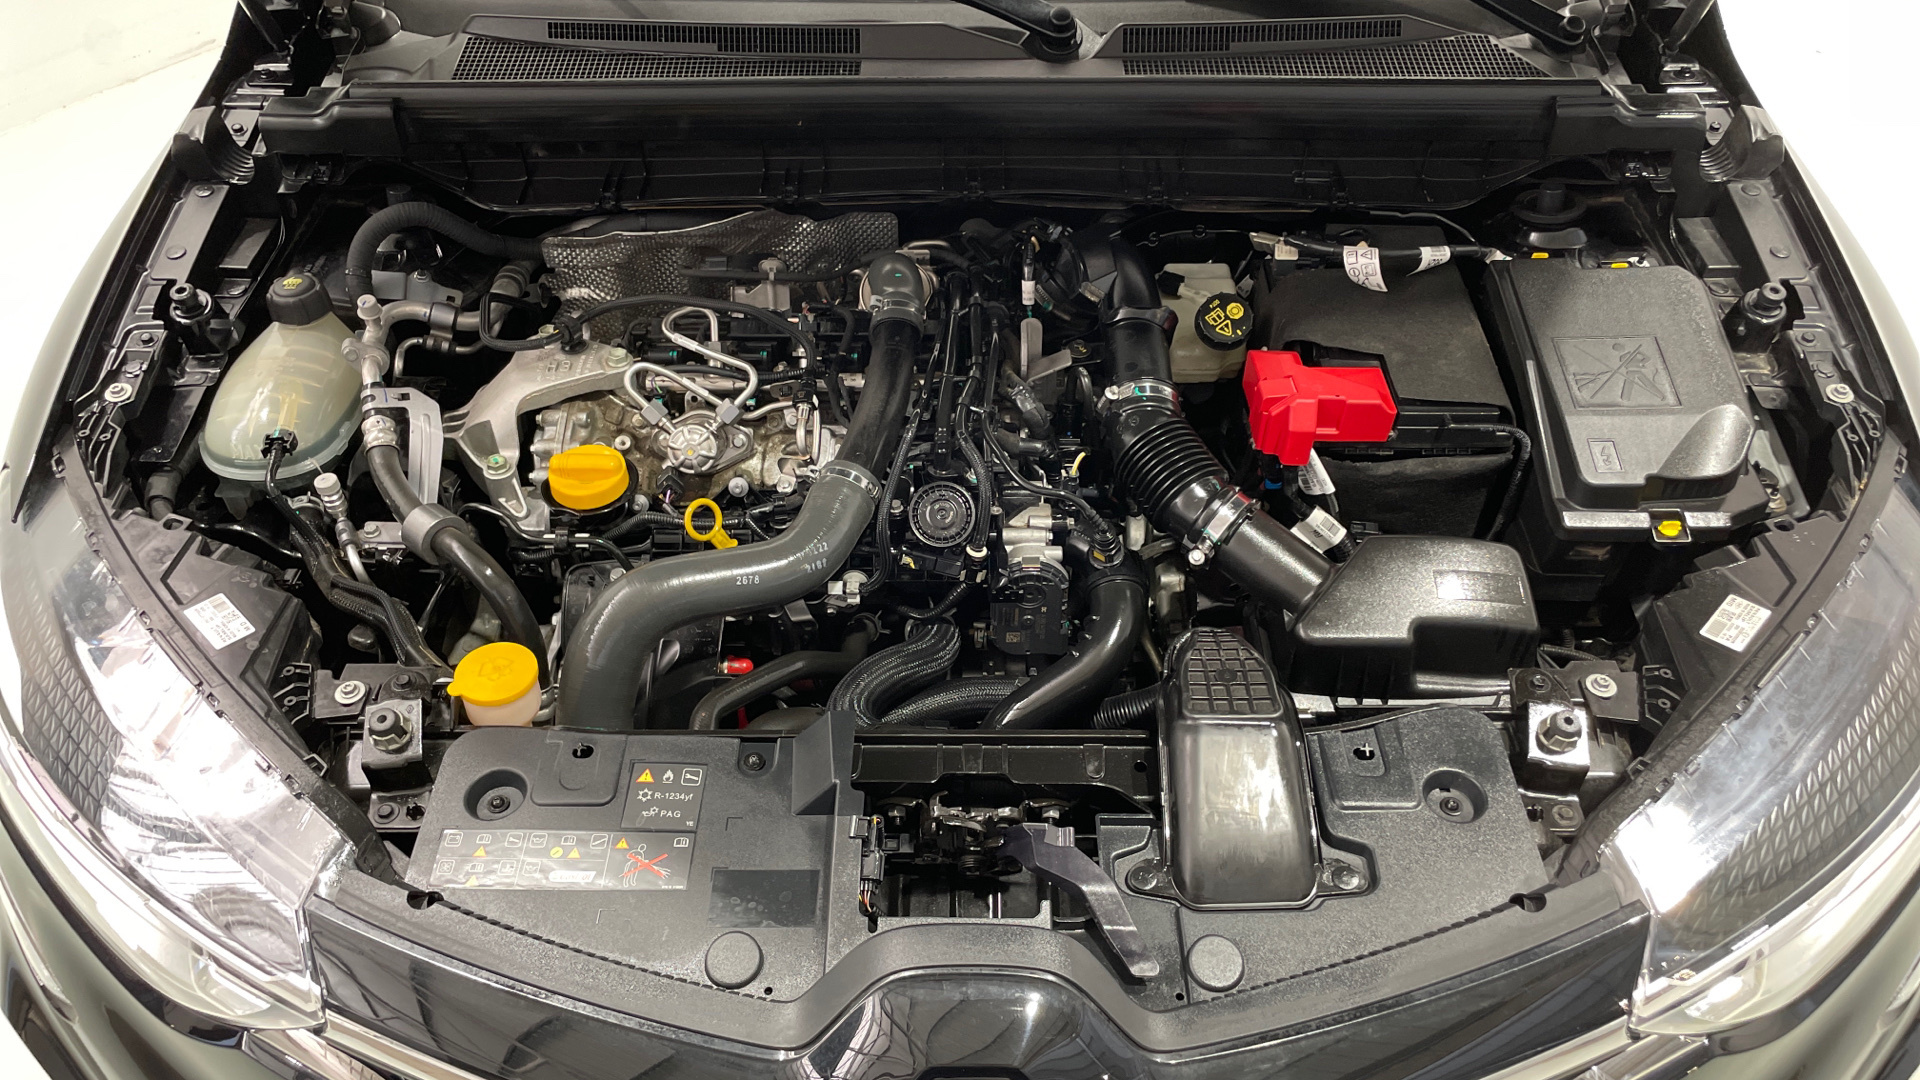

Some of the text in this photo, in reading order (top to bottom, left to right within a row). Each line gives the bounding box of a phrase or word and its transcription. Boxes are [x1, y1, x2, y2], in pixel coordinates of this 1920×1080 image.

[736, 575, 760, 585] 2678
[654, 792, 694, 801] R-1234yf
[660, 810, 681, 818] PAG
